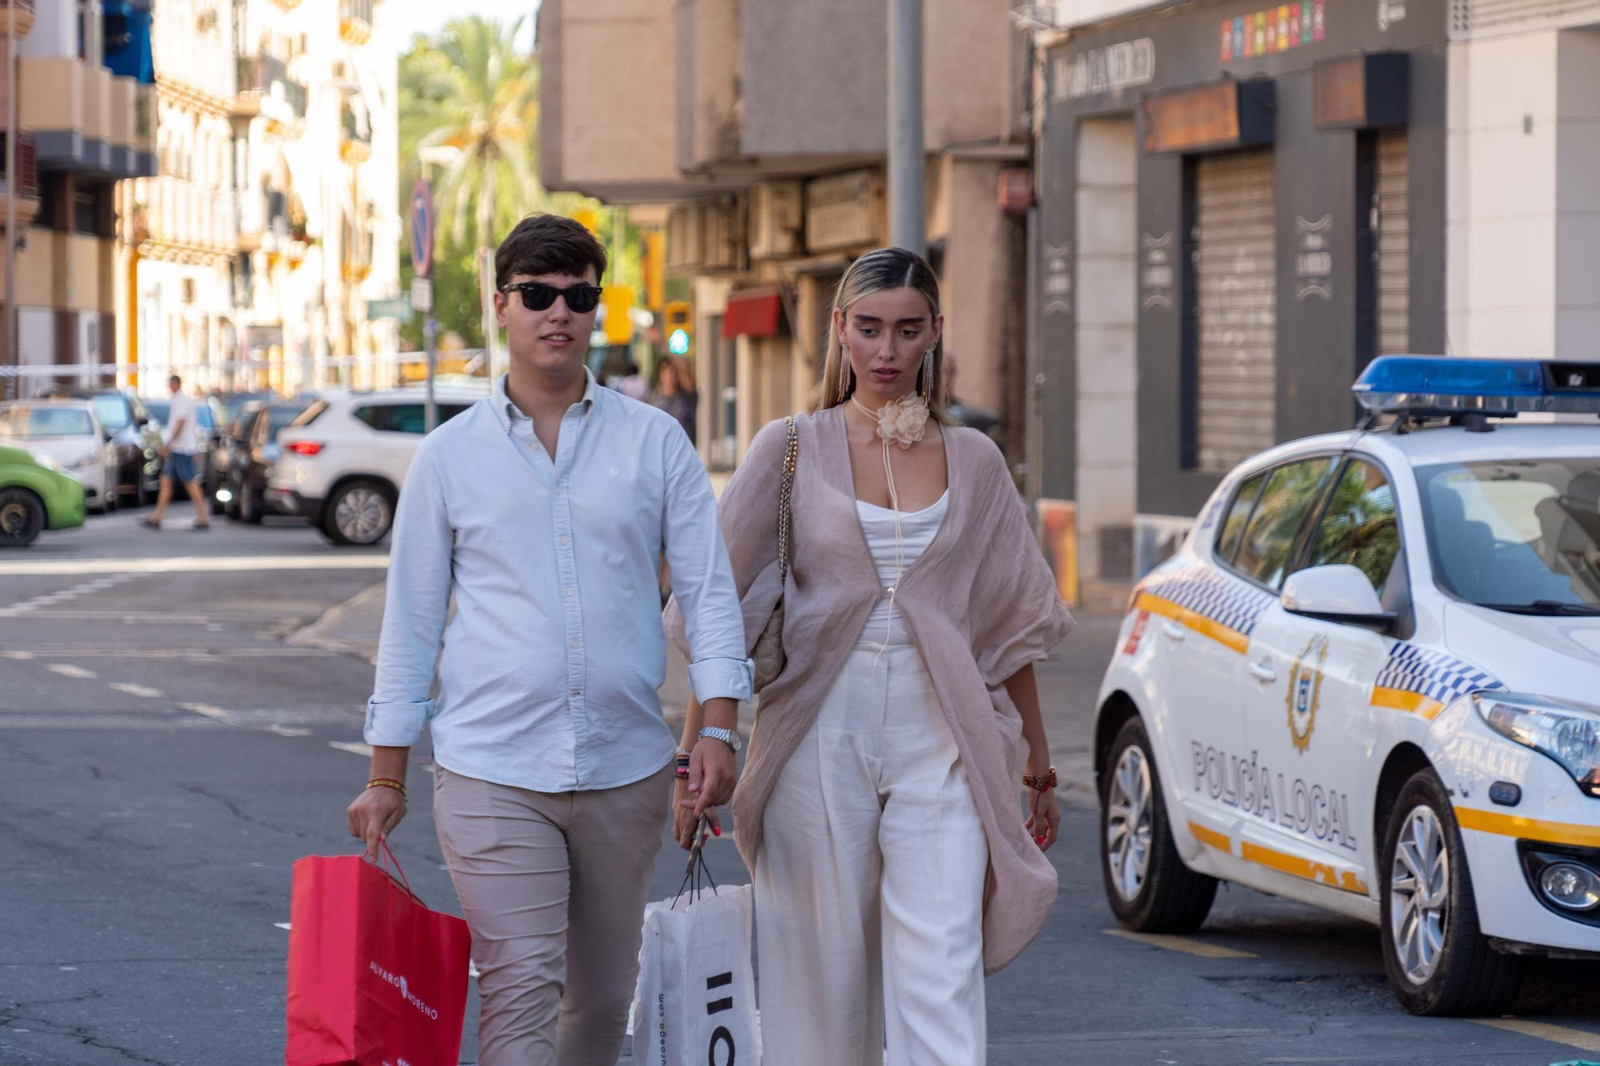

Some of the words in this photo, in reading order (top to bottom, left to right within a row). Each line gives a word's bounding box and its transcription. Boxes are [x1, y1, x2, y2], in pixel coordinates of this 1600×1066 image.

[1191, 739, 1276, 823] POLICÍA
[1278, 772, 1358, 852] LOCAL
[369, 961, 400, 988] ALVARO
[407, 991, 438, 1020] MORENO
